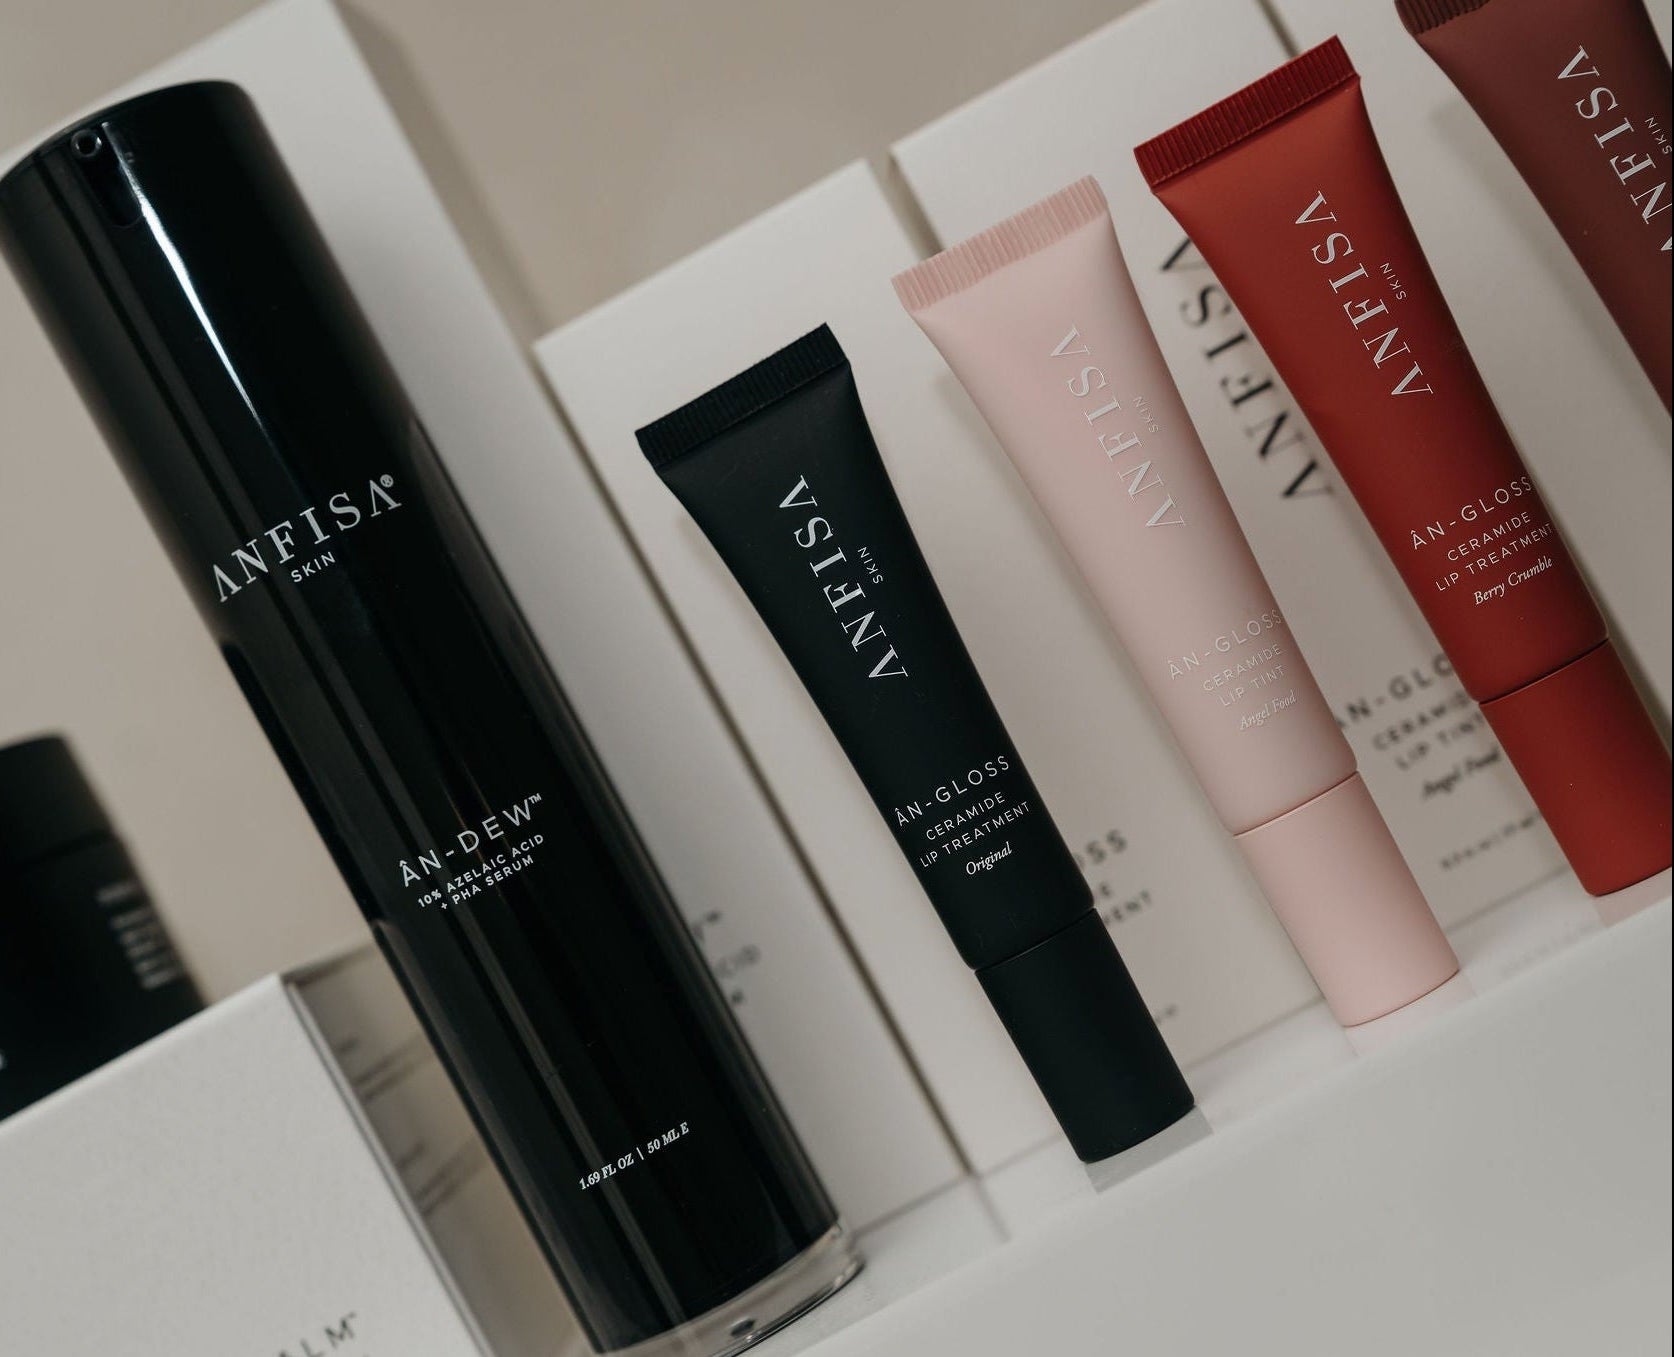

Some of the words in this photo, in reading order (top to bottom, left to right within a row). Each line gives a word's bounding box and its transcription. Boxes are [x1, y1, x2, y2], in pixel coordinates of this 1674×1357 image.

[1295, 190, 1434, 396] ANFISA
[1379, 262, 1407, 300] SKIN
[1050, 326, 1187, 529] ANFISA
[1133, 396, 1159, 433] SKIN
[1410, 476, 1532, 550] ÂN-GLOSS
[1447, 511, 1531, 561] CERAMIDE
[291, 551, 337, 583] SKIN
[779, 475, 909, 682] ANFISA
[857, 546, 884, 585] SKIN
[1435, 572, 1459, 592] LIP
[1465, 523, 1554, 575] TREATMENT
[1473, 582, 1506, 605] Berry
[1508, 555, 1553, 587] Crumble
[1167, 609, 1283, 681] ÂN-GLOSS
[1203, 643, 1282, 691] CERAMIDE
[1219, 687, 1245, 707] LIP
[1250, 664, 1286, 689] TINT
[1240, 703, 1271, 731] Angel
[1272, 689, 1297, 713] Food
[894, 755, 1010, 827] ÂN-GLOSS
[926, 791, 1006, 841] CERAMIDE
[919, 850, 939, 868] LIP
[942, 801, 1031, 855] TREATMENT
[965, 840, 1013, 875] Original
[418, 888, 442, 908] 10%
[446, 854, 507, 893] AZELAIC
[511, 834, 545, 858] ACID
[451, 884, 482, 905] PHA
[485, 854, 535, 886] SERUM
[579, 1171, 601, 1190] 1.69
[601, 1163, 617, 1179] FL
[617, 1152, 635, 1170] OZ
[647, 1138, 661, 1154] 50
[661, 1128, 680, 1146] ML
